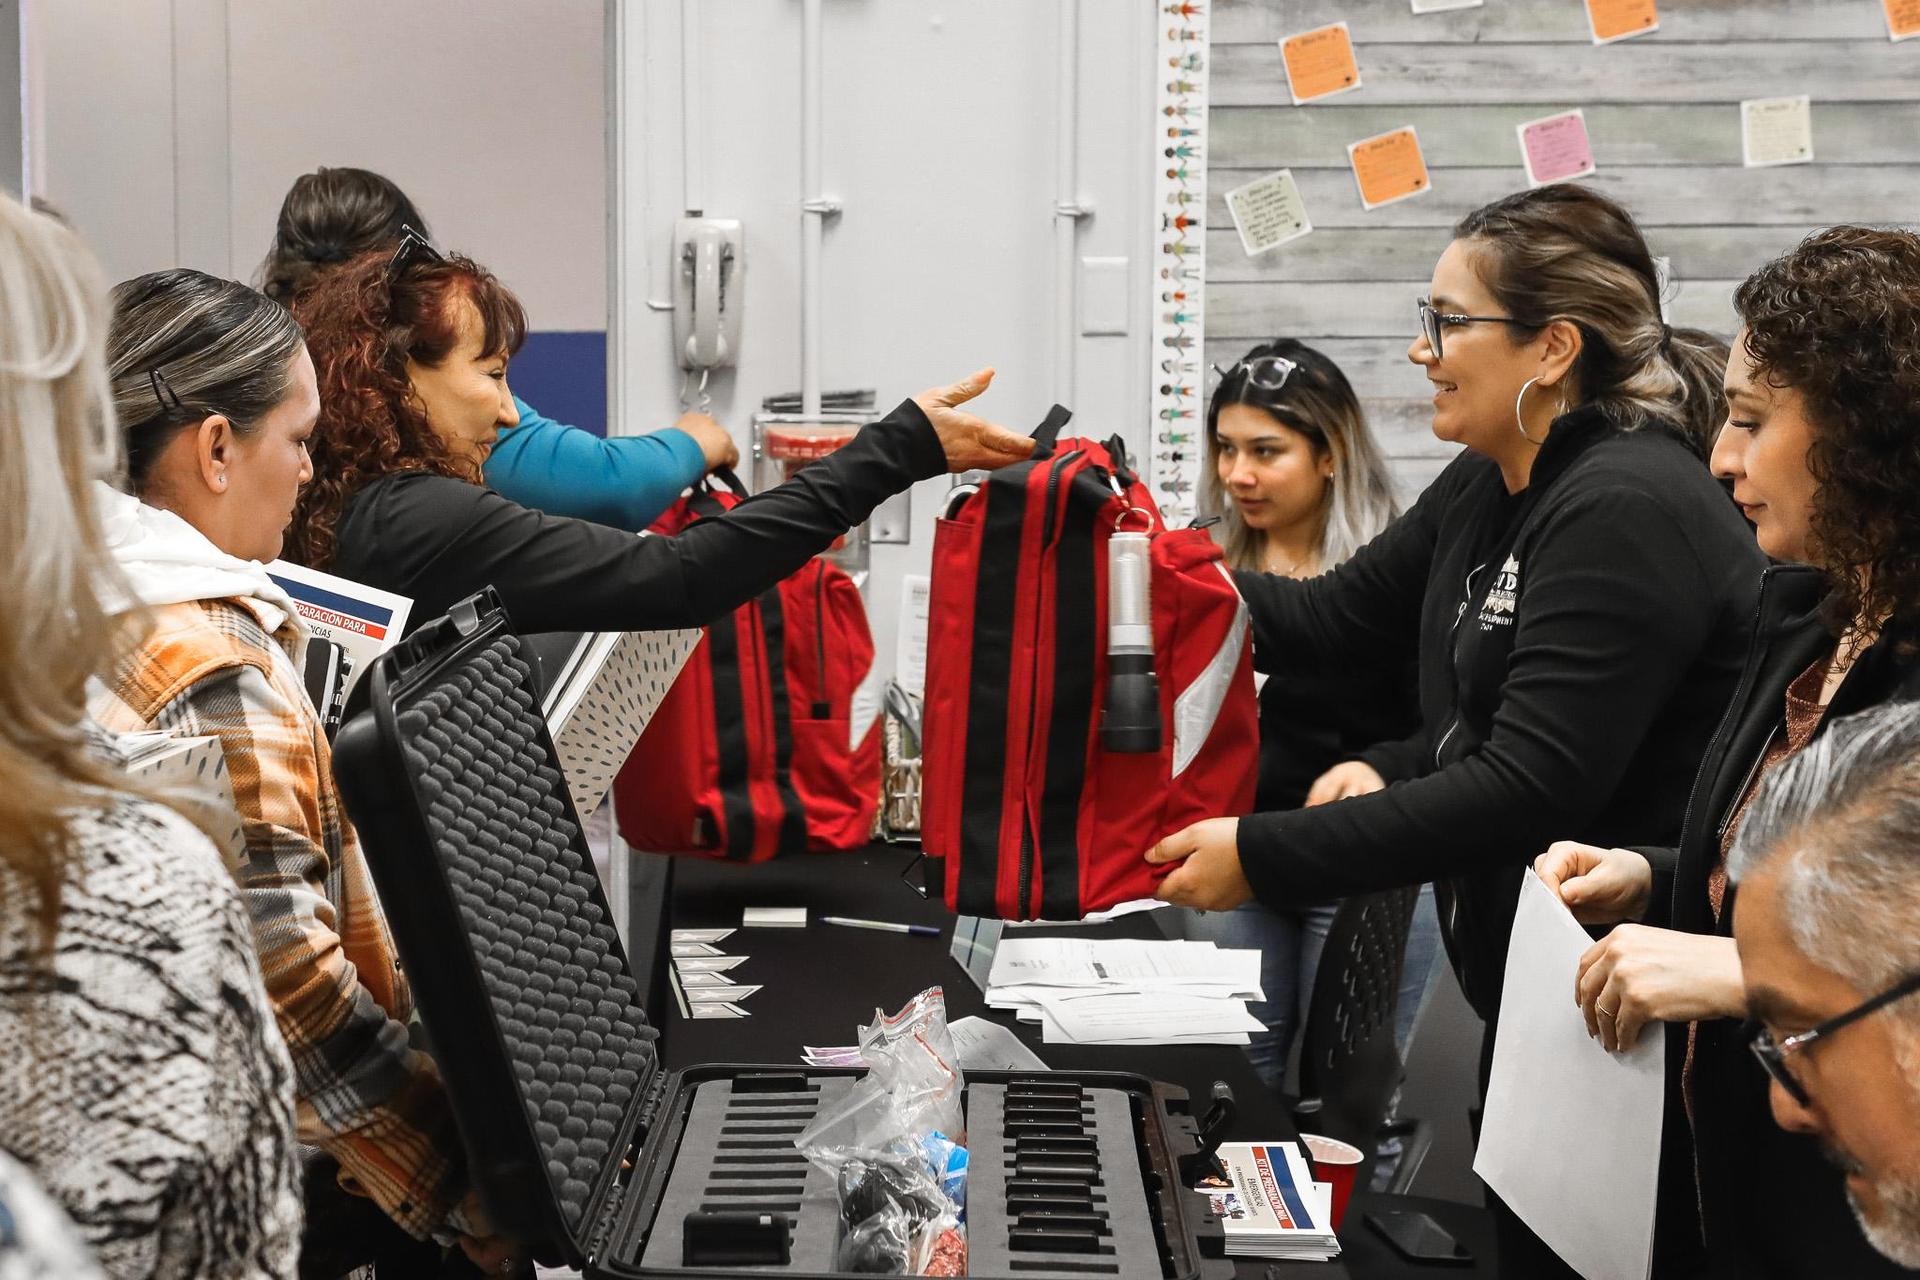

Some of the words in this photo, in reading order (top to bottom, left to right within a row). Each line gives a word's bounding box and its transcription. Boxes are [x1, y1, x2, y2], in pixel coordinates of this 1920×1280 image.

[342, 619, 366, 634] PARA
[1256, 1158, 1268, 1168] KIT
[1260, 1168, 1271, 1176] DE
